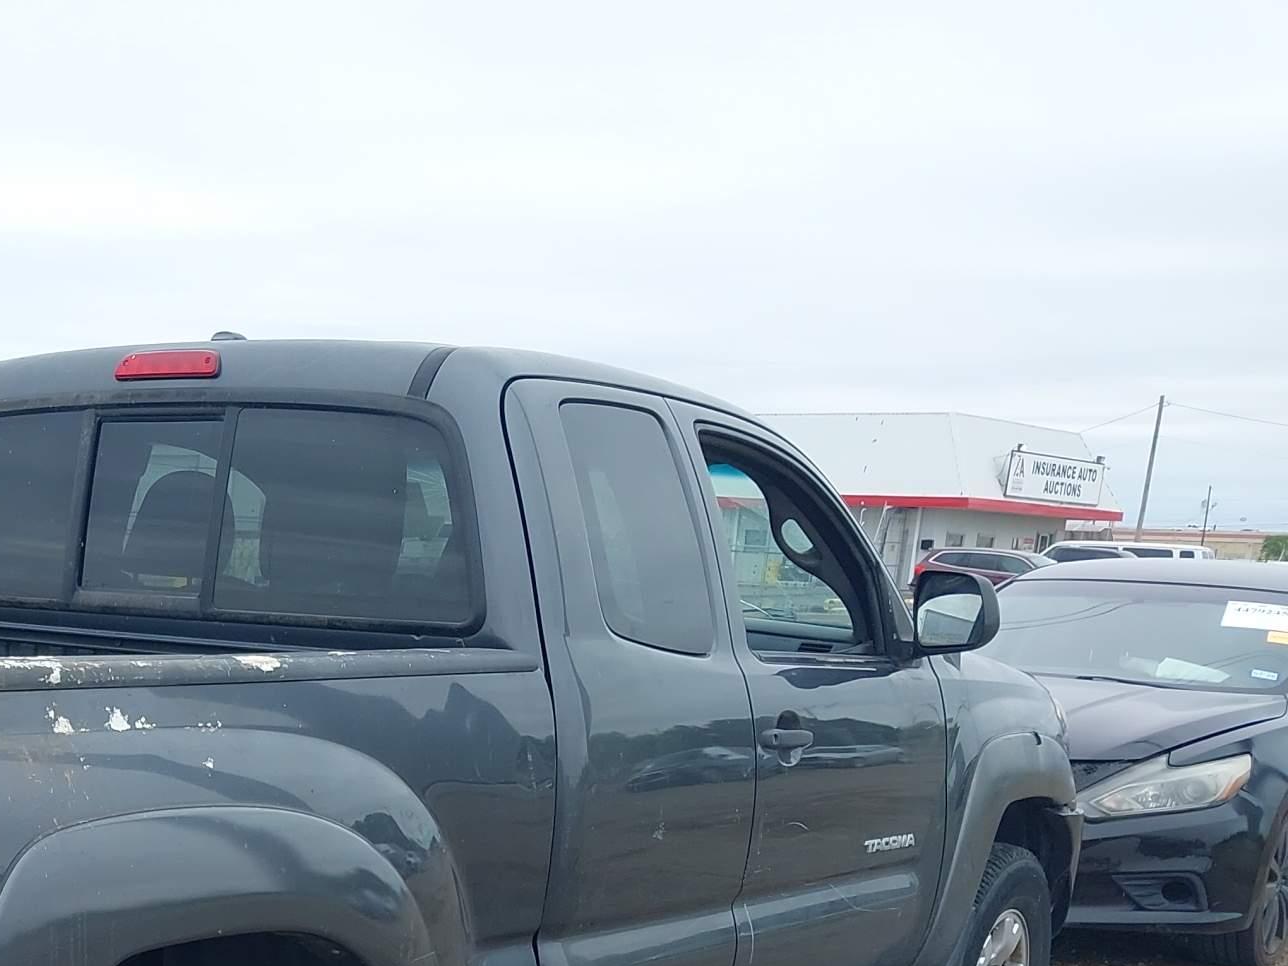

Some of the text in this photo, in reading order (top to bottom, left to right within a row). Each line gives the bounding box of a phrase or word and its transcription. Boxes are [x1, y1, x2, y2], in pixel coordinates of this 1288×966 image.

[1032, 461, 1077, 480] INSURANCE
[1077, 468, 1097, 482] AUTO
[1043, 480, 1081, 497] AUCTIONS
[864, 833, 915, 853] TACOMA
